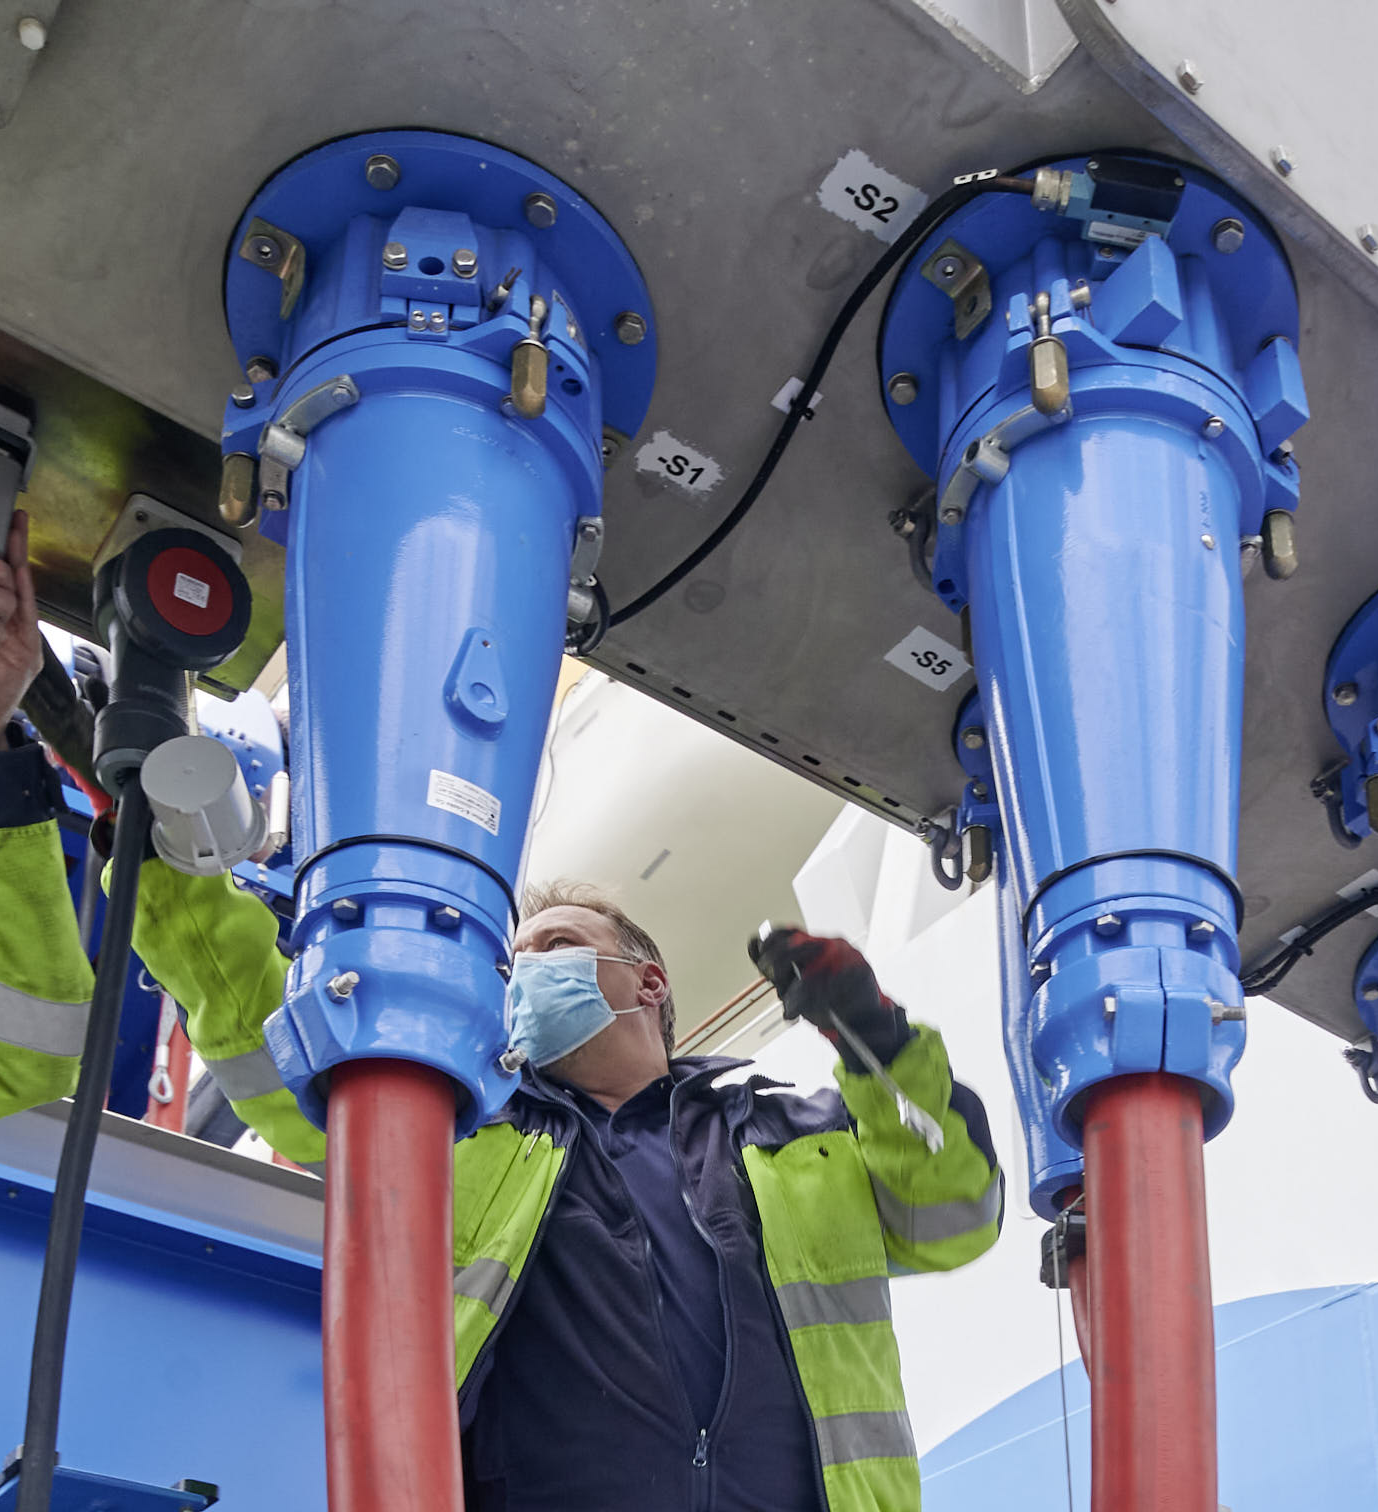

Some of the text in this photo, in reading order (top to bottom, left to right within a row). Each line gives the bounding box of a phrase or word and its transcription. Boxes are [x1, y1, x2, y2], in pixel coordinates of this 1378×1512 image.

[844, 183, 900, 224] -S2
[657, 455, 705, 485] -S1
[910, 651, 953, 676] -S5
